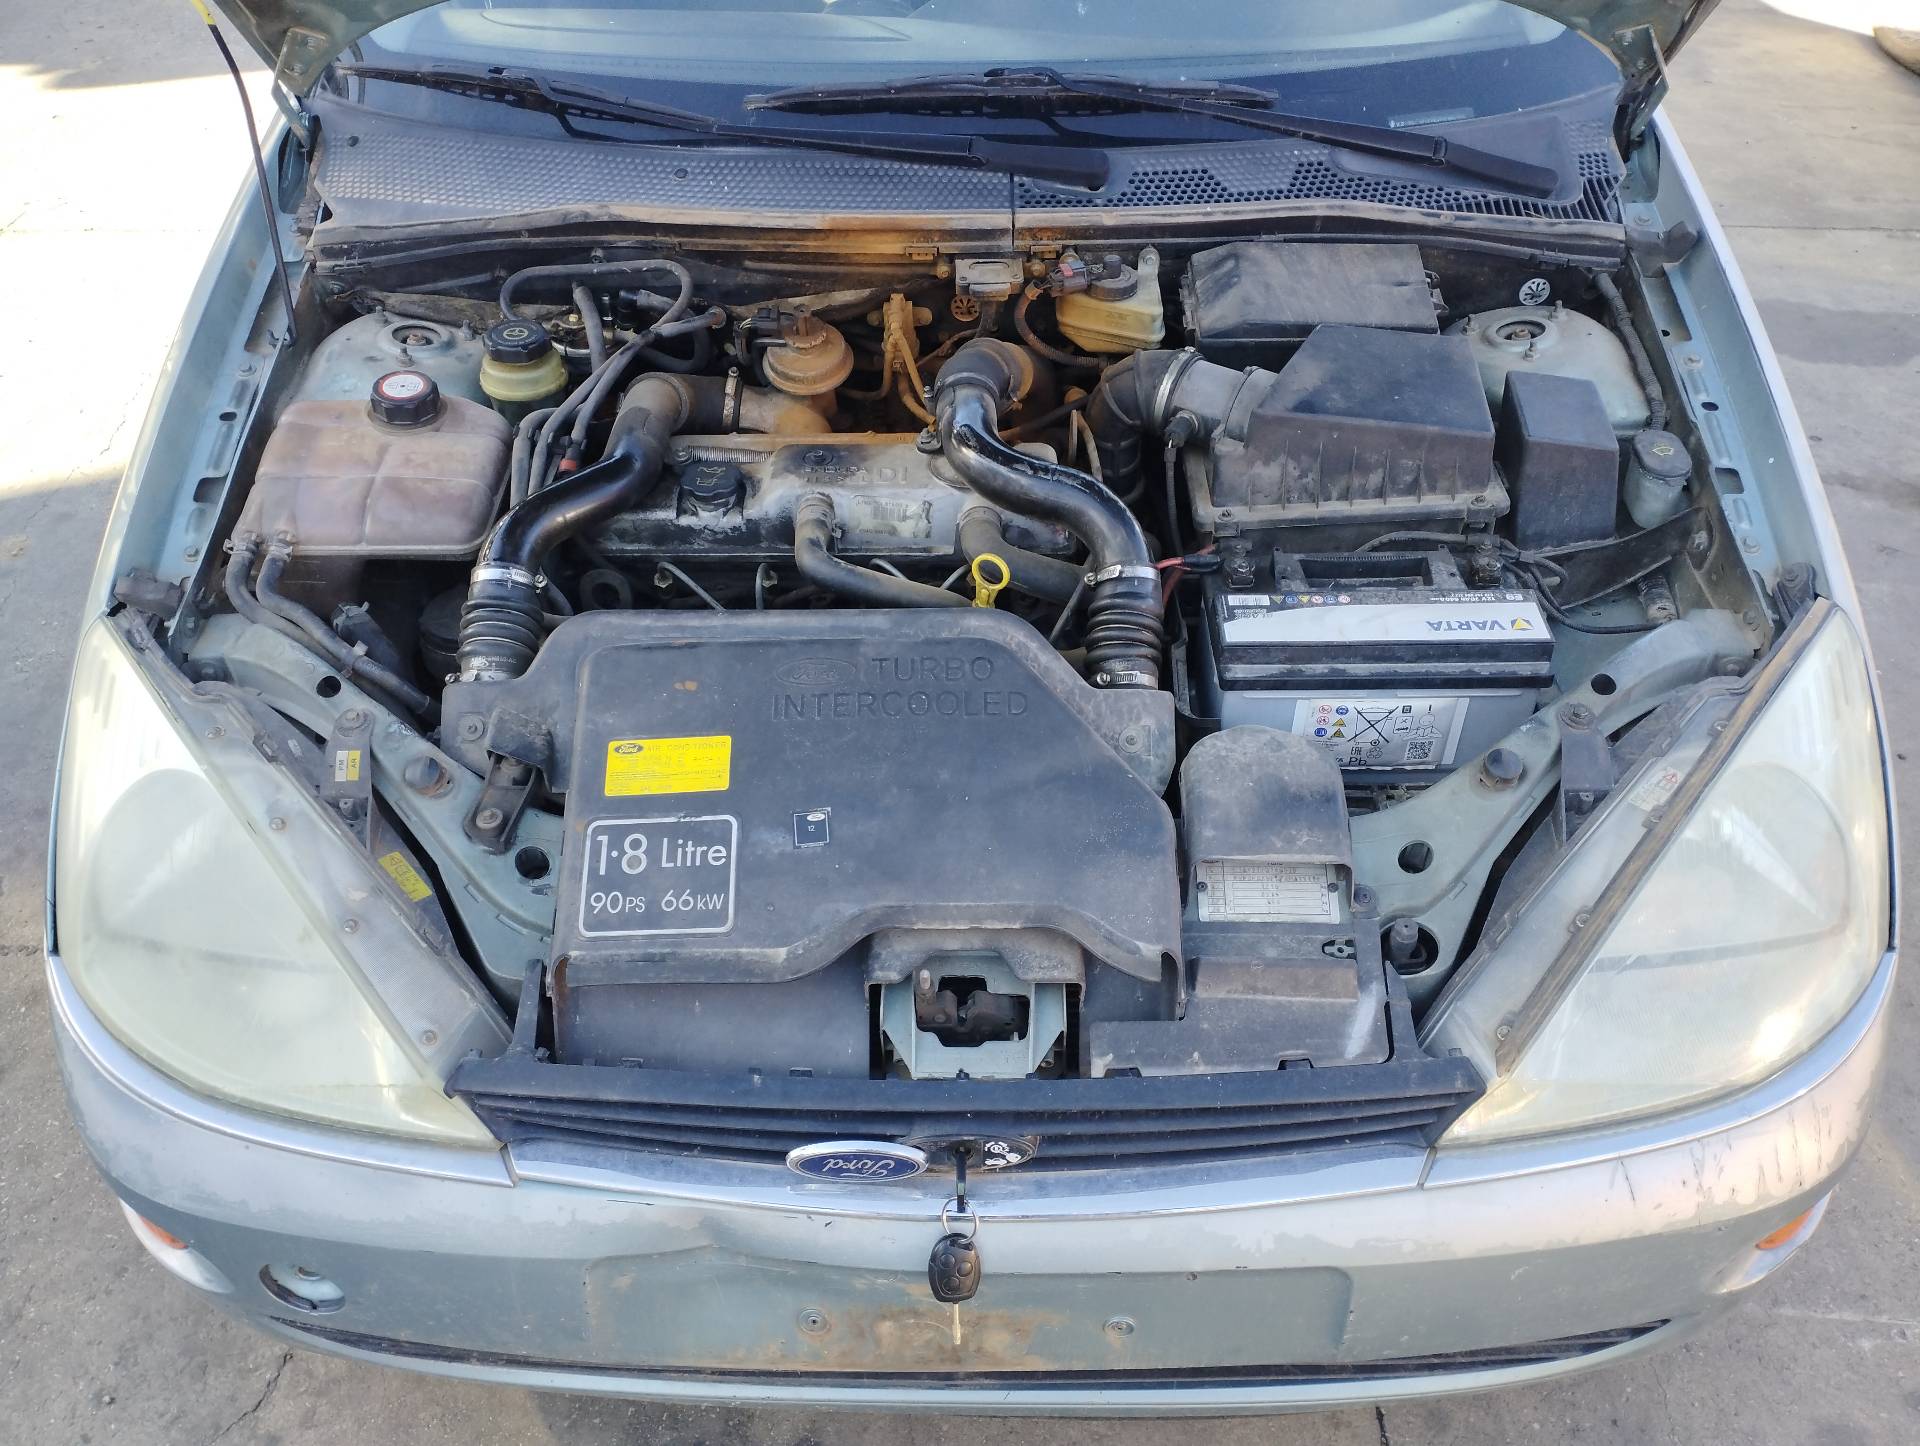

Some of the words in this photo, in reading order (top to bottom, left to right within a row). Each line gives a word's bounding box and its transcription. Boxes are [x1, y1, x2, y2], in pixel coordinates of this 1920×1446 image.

[1425, 620, 1507, 632] VARTA
[871, 656, 993, 681] TURBO
[771, 690, 1029, 721] INTERCOOLED
[661, 837, 727, 867] Litre
[821, 1158, 896, 1177] Ford
